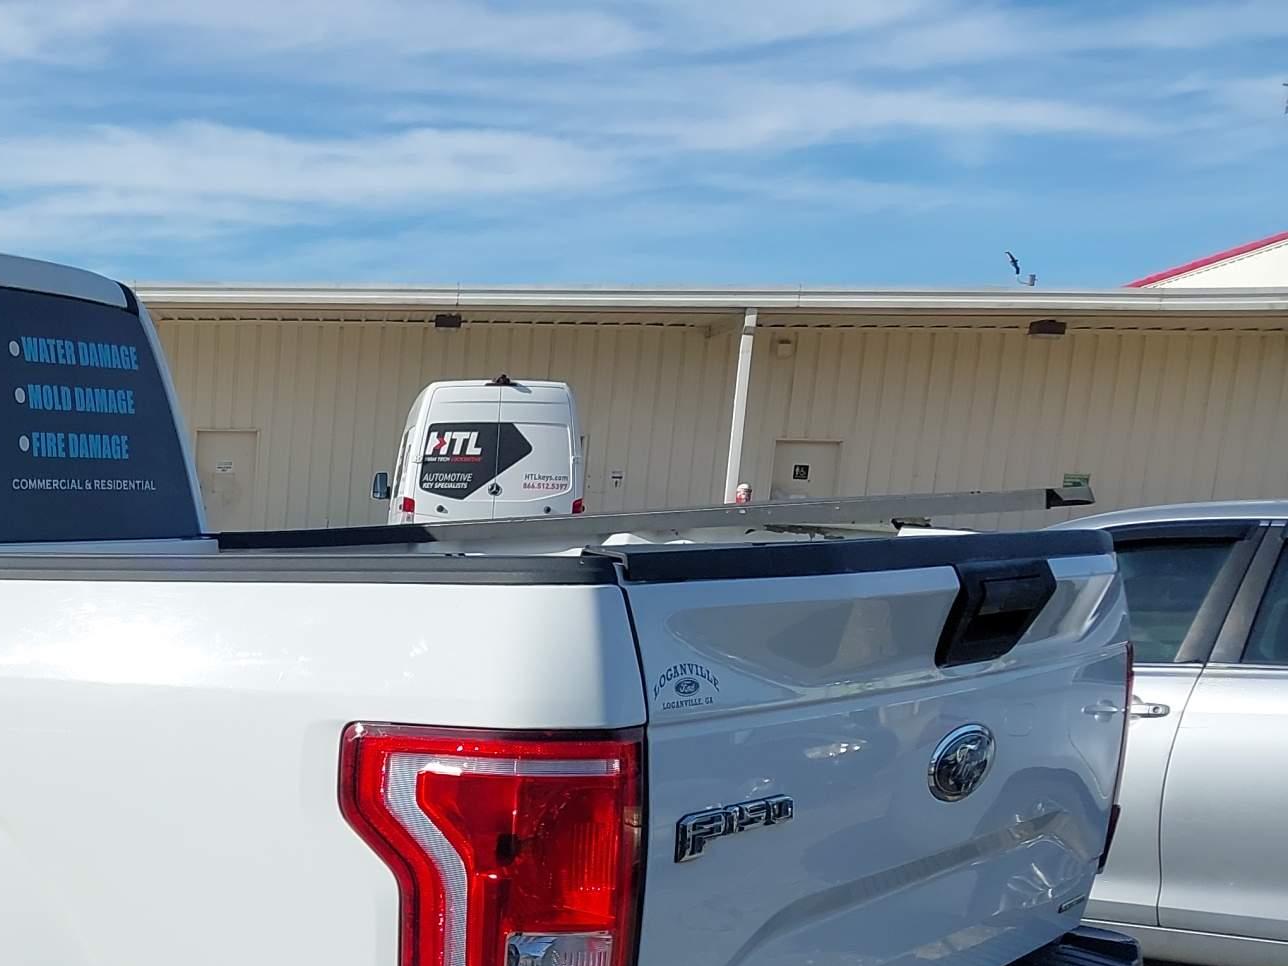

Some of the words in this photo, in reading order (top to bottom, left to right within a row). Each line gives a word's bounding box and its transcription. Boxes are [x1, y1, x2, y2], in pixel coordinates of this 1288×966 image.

[21, 336, 76, 365] WATER
[79, 341, 139, 370] DAMAGE
[27, 384, 72, 411] MOLD
[75, 387, 136, 415] DAMAGE
[31, 432, 66, 458] FIRE
[69, 433, 129, 460] DAMAGE
[425, 431, 482, 456] HTL
[12, 478, 83, 491] COMMERCIAL
[85, 480, 92, 491] &
[94, 479, 156, 491] RESIDENTIAL
[422, 472, 472, 482] AUTOMOTIVE
[653, 663, 720, 701] LOGANVILLE
